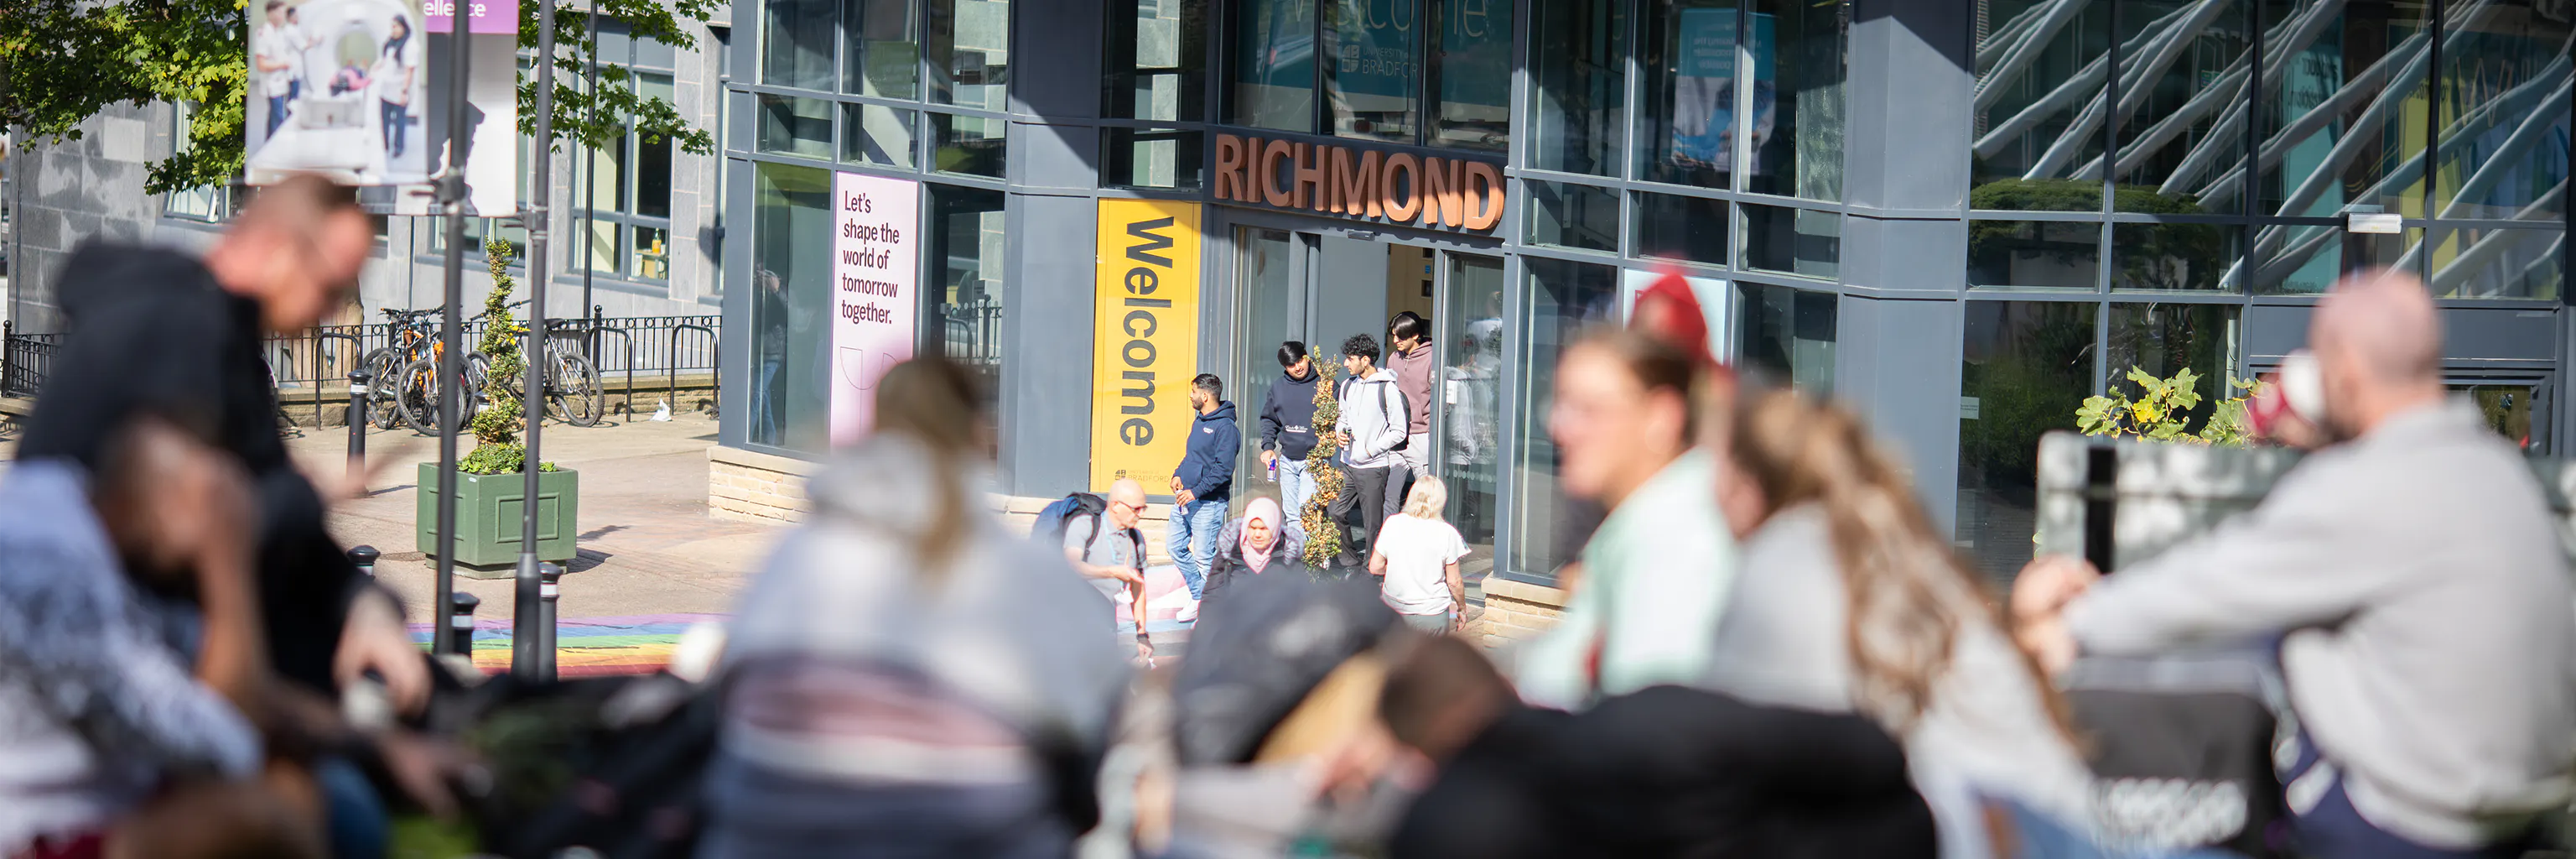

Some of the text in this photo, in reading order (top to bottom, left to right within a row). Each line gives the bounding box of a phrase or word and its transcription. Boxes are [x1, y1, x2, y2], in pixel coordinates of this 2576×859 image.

[1362, 59, 1418, 79] BRADFOR
[1214, 133, 1504, 230] RICHMOND
[844, 190, 871, 213] Let's
[844, 218, 900, 245] shape the
[843, 247, 891, 269] world of
[842, 273, 898, 298] tomorrow
[841, 299, 892, 325] together.
[1119, 216, 1174, 446] Welcome
